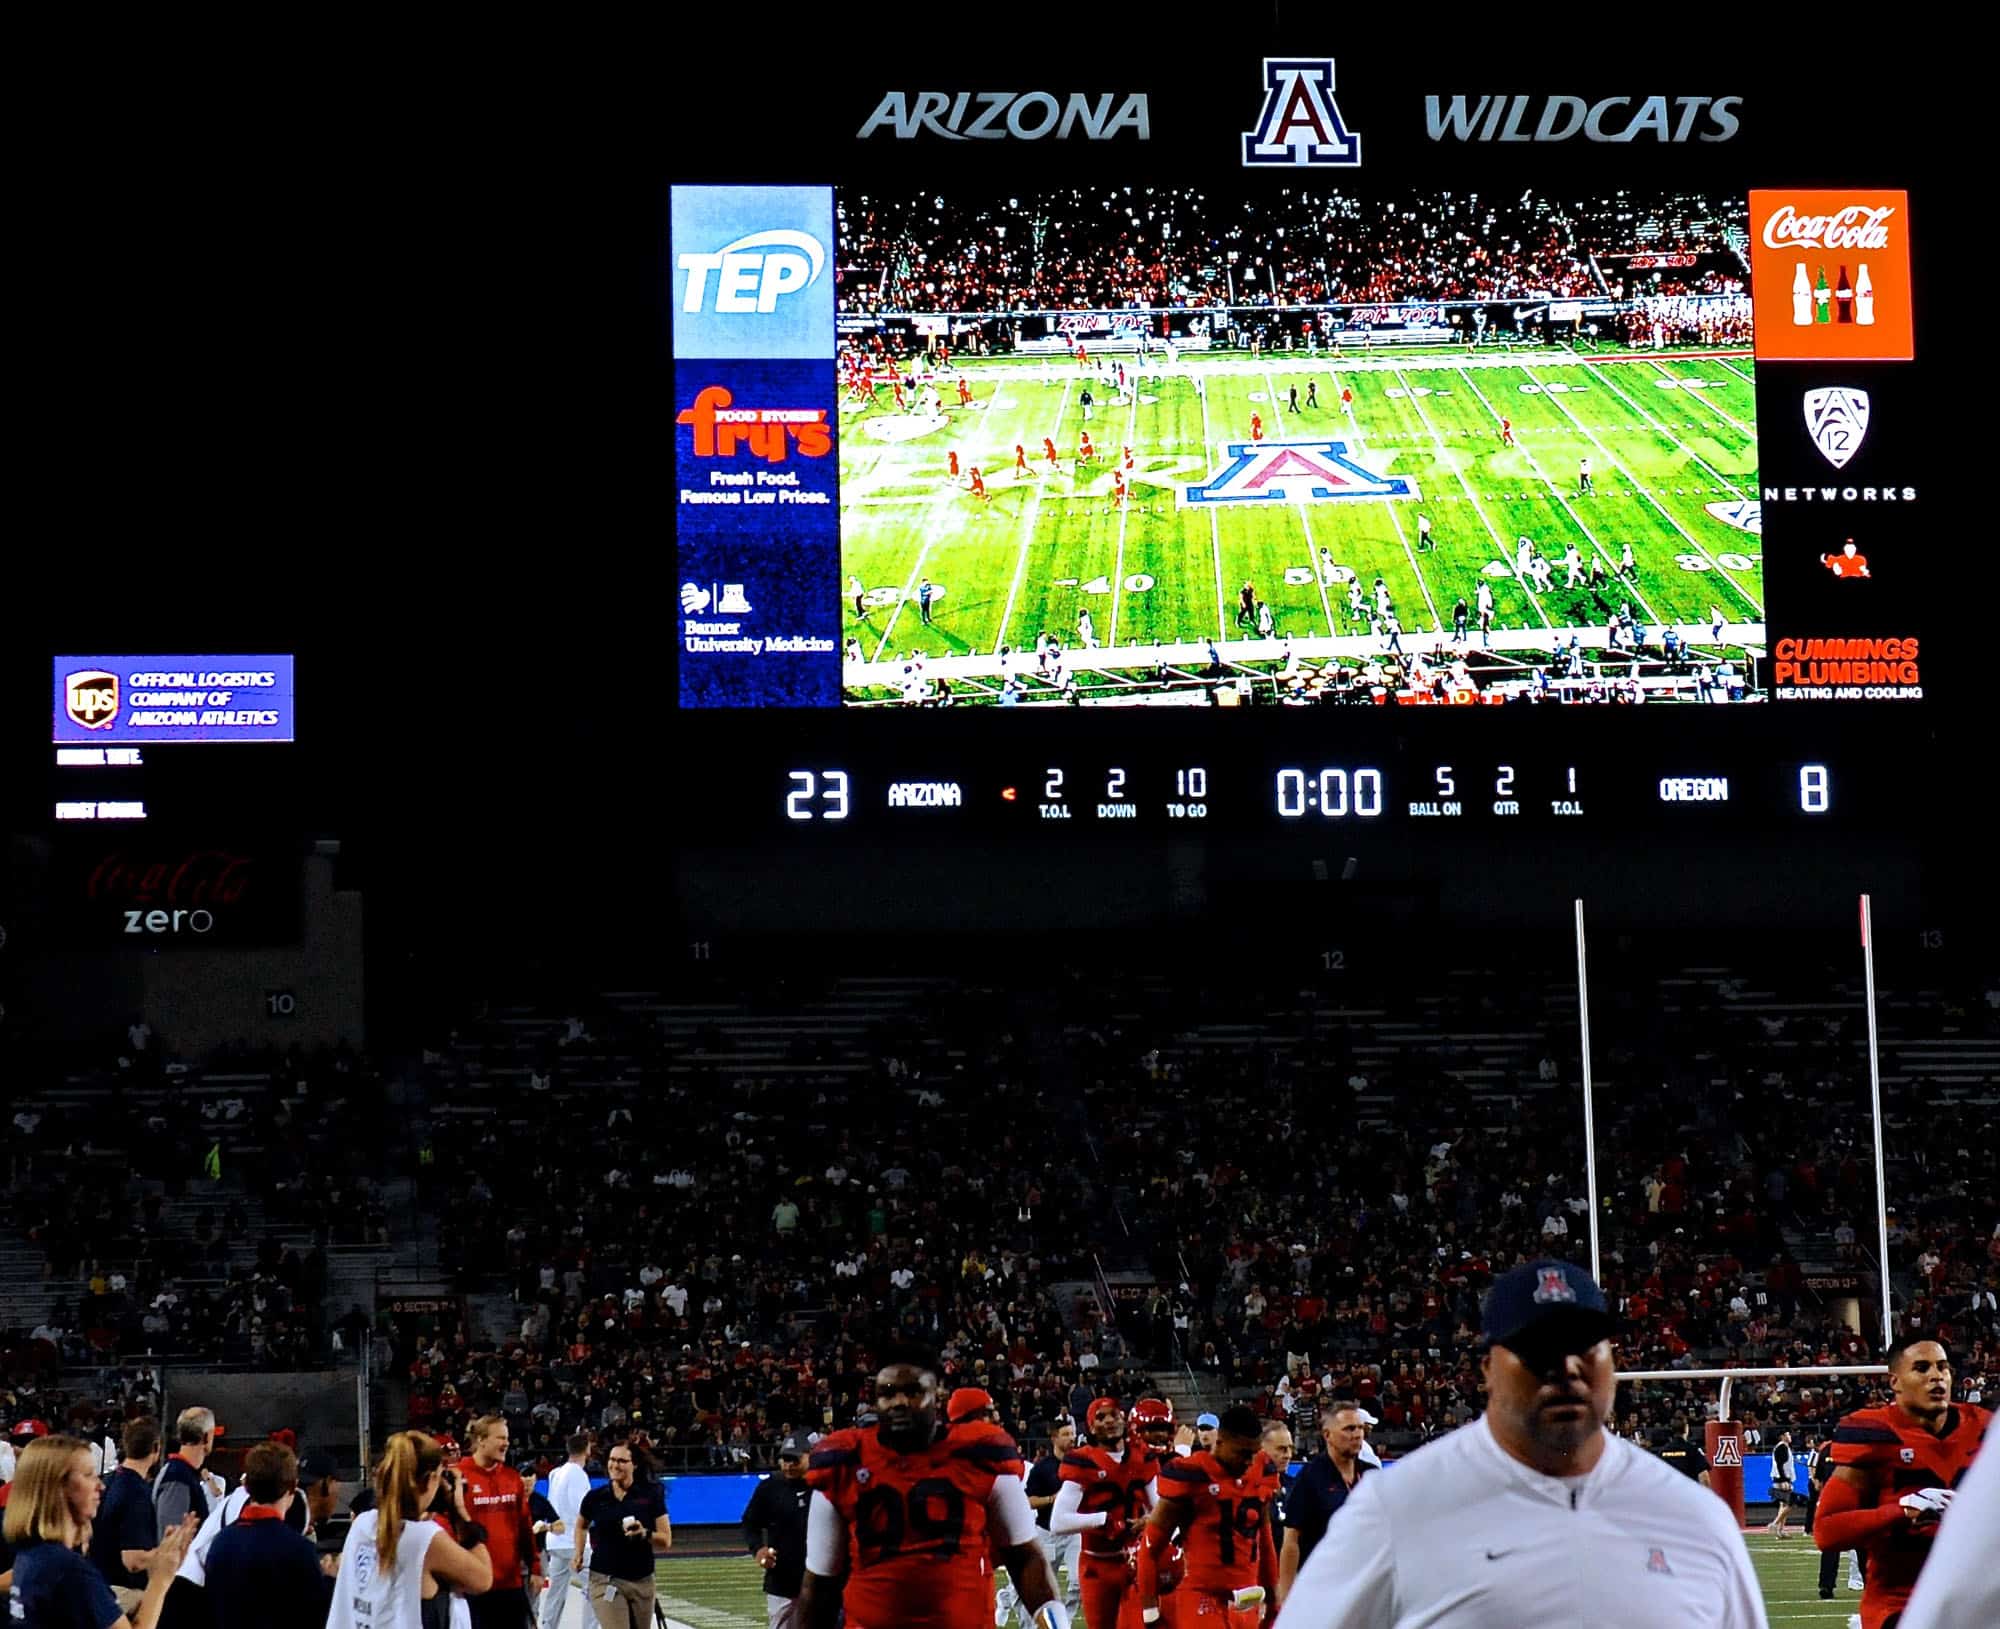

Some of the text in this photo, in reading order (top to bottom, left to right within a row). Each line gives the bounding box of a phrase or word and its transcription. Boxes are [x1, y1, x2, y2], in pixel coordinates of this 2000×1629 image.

[857, 90, 1151, 141] ARIZONA
[1424, 94, 1744, 142] WILDCATS
[677, 252, 812, 314] TEP
[1827, 430, 1850, 451] 12
[710, 471, 800, 486] Fresh Food.
[680, 489, 831, 505] Famous Low Prices.
[1763, 486, 1917, 501] NETWORKS
[684, 620, 742, 636] Banner
[685, 636, 835, 656] University Medicine
[1775, 637, 1920, 661] CUMMINGS
[128, 672, 276, 688] OFFICIAL LOGISTICS
[1775, 661, 1920, 685] PLUMBING
[70, 687, 116, 721] ups
[128, 691, 234, 707] COMPANY OF
[1775, 687, 1924, 700] HEATING AND COOLING
[127, 710, 279, 726] ARIZONA ATHLETICS
[1045, 768, 1064, 798] 2
[1107, 768, 1126, 798] 2
[1176, 767, 1208, 798] 10
[1435, 766, 1455, 796] 5
[1496, 766, 1516, 796] 2
[1567, 767, 1576, 793] 1
[1658, 777, 1730, 802] OREGON
[1799, 764, 1830, 814] 8
[785, 769, 852, 821] 23
[886, 782, 962, 807] ARIZONA
[1275, 767, 1384, 818] 0:00
[1097, 803, 1137, 819] DOWN
[1166, 803, 1208, 818] TO GO
[1408, 801, 1462, 817] BALL ON
[1493, 800, 1520, 816] QTR
[122, 909, 214, 933] zero
[1320, 951, 1345, 969] 12
[268, 994, 295, 1014] 10
